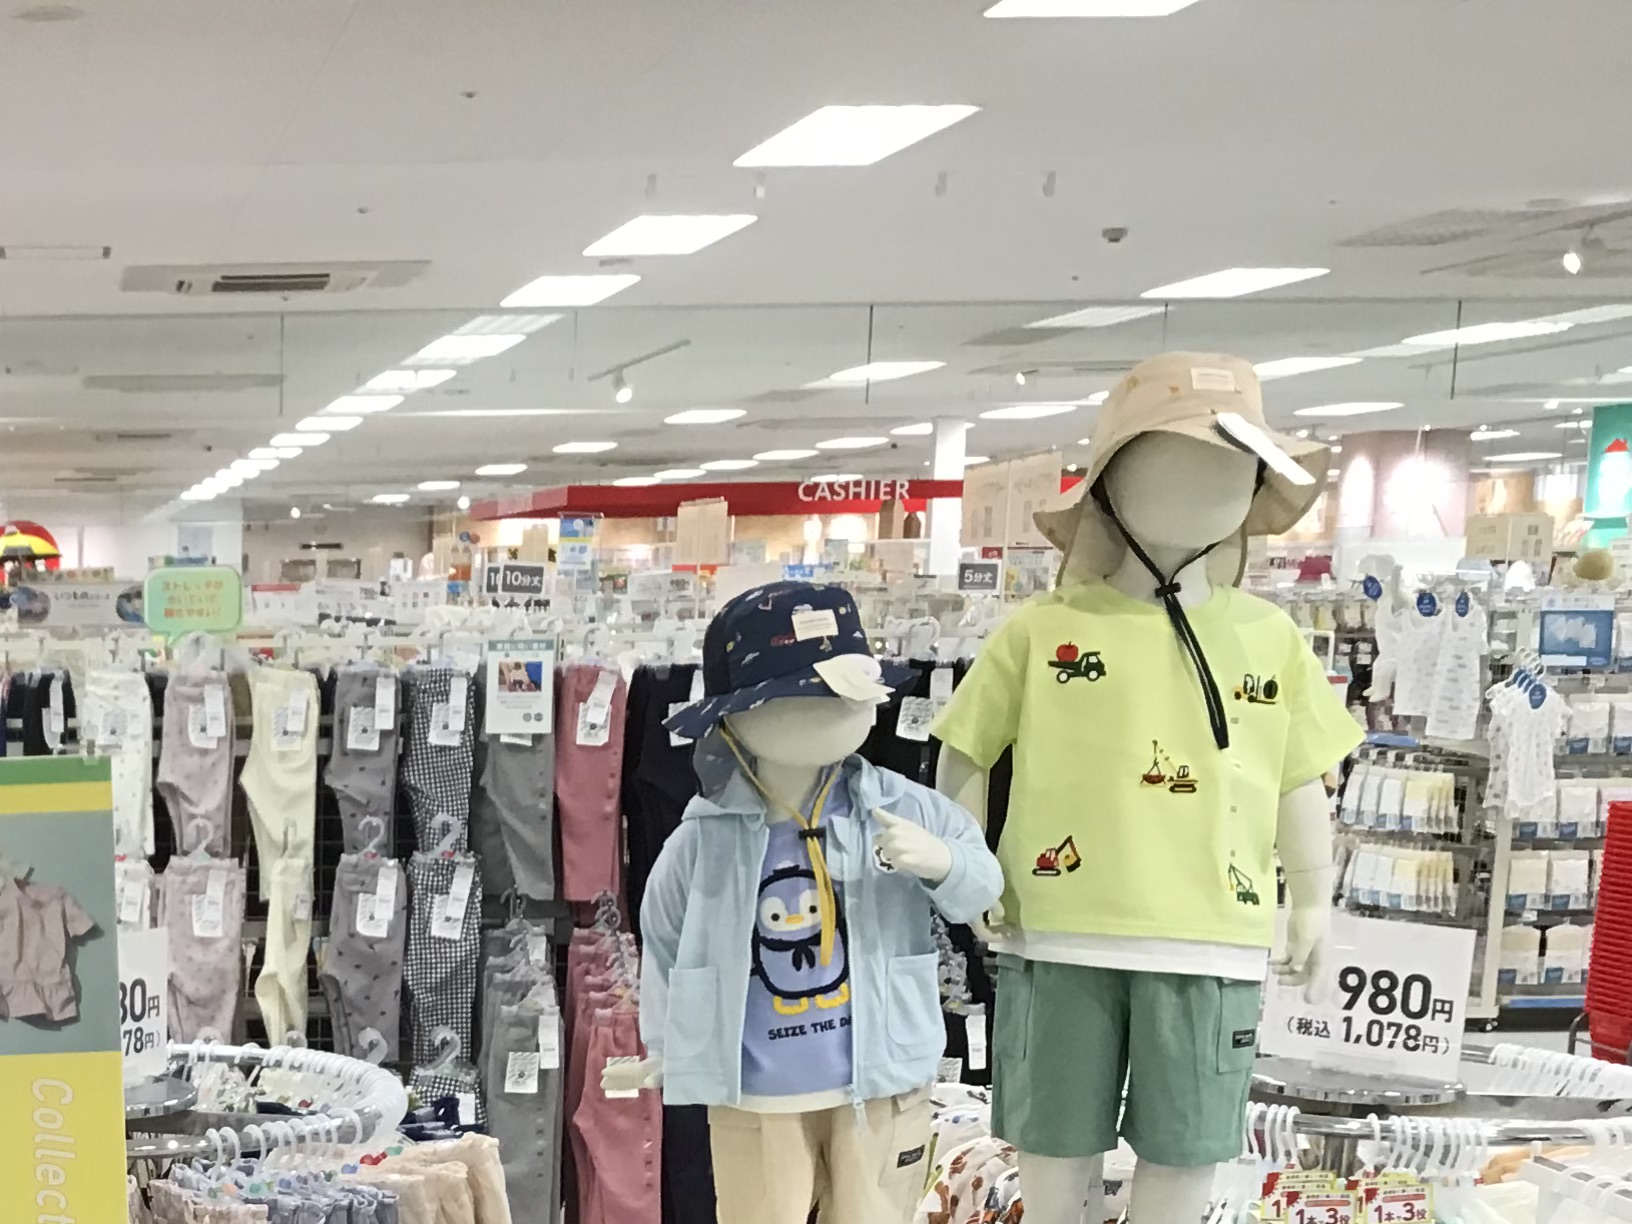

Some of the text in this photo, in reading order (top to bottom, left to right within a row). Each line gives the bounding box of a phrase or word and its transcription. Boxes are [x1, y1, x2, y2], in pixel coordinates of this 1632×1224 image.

[798, 480, 910, 502] CASHIER
[1338, 966, 1454, 1024] 980円
[768, 1024, 807, 1041] SEIZE
[811, 1019, 836, 1034] THE
